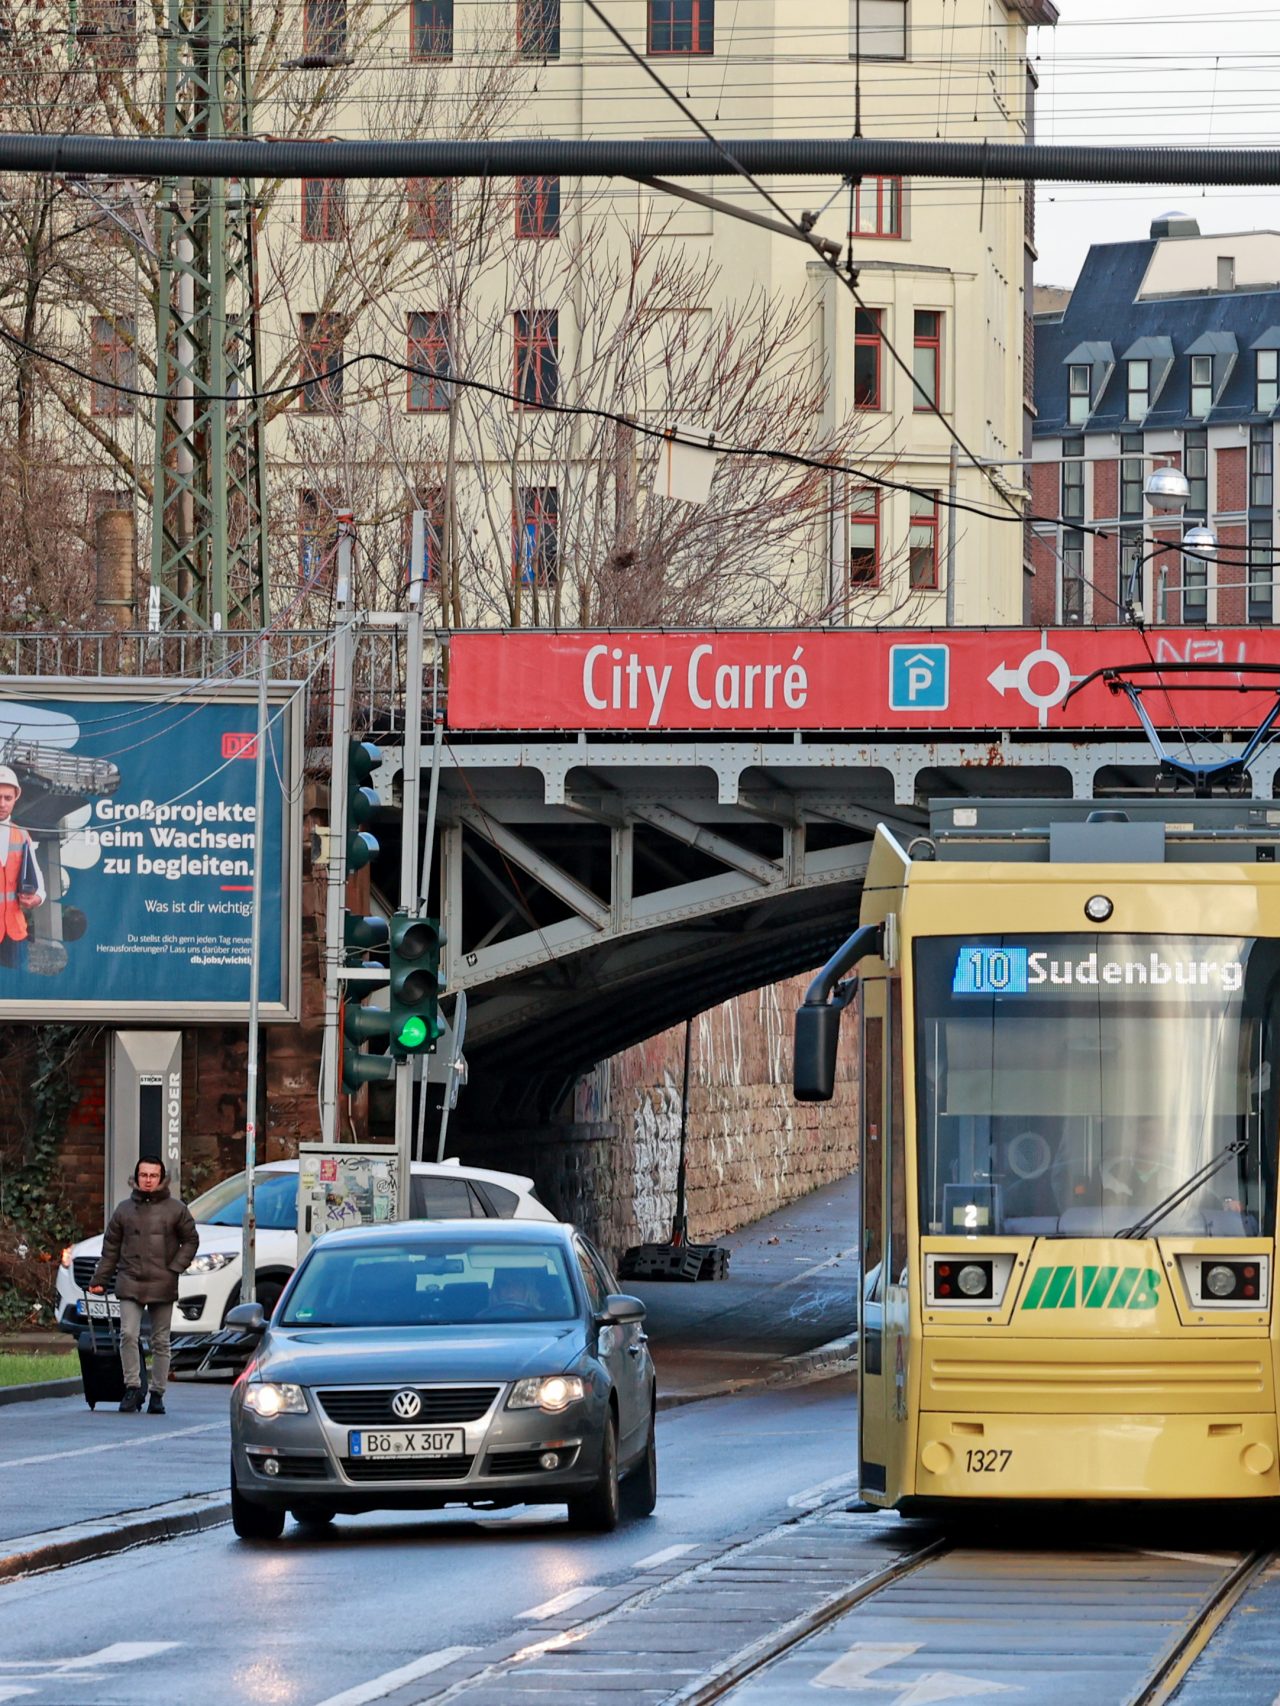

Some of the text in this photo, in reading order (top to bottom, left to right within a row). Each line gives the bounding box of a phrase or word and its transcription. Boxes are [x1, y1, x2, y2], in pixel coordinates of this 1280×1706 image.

[582, 644, 808, 726] City Carré
[908, 667, 932, 701] P
[95, 799, 256, 825] Großprojekte
[84, 826, 256, 850] beim Wachsen
[103, 854, 255, 881] zu begleiten.
[144, 899, 169, 913] Was
[172, 900, 186, 913] ist
[189, 901, 205, 914] dir
[96, 944, 169, 955] Herausforderungen?
[170, 946, 185, 954] Lass
[201, 945, 230, 954] darüber
[127, 934, 138, 943] Du
[162, 934, 178, 943] dich
[179, 935, 195, 946] gern
[196, 935, 217, 946] jeden
[219, 936, 231, 946] Tag
[968, 950, 1243, 992] 10 Sudenburg
[168, 1072, 180, 1160] STRÖER
[965, 1204, 978, 1228] 2
[367, 1434, 392, 1452] BÖ
[404, 1434, 416, 1452] X
[420, 1432, 455, 1451] 307
[966, 1448, 1013, 1473] 1327
